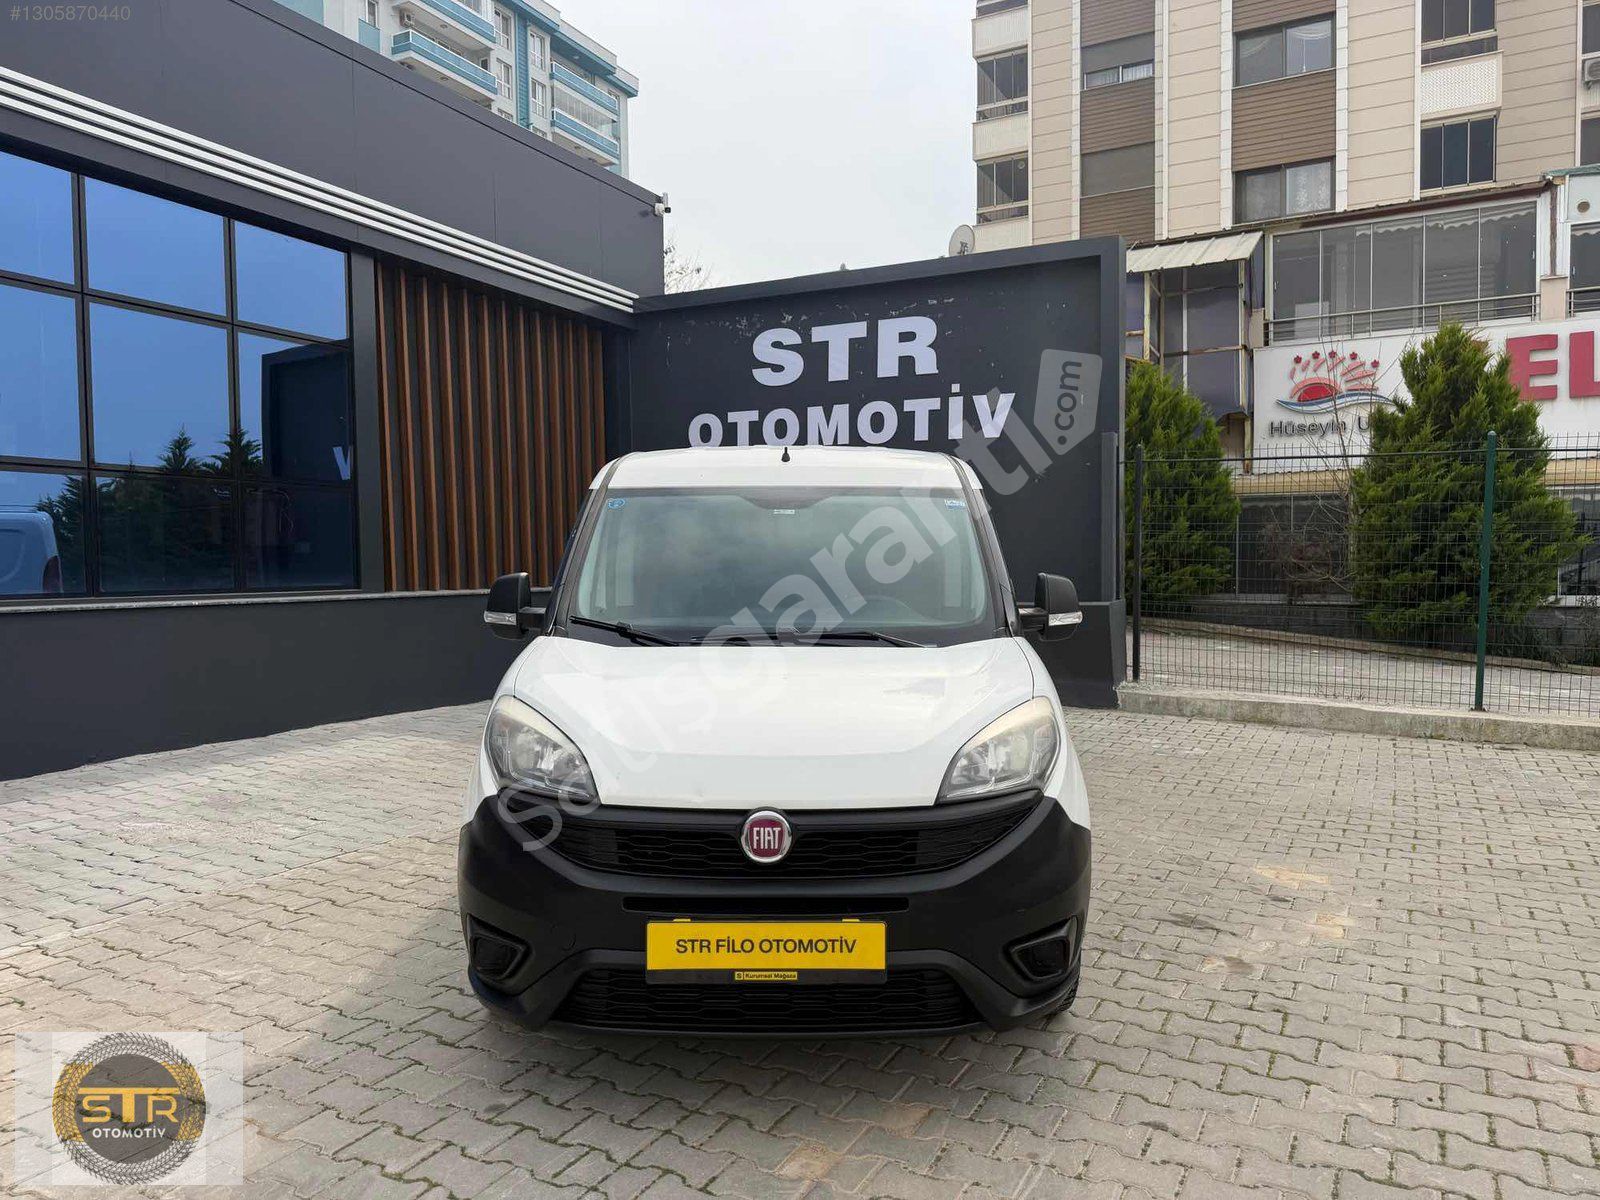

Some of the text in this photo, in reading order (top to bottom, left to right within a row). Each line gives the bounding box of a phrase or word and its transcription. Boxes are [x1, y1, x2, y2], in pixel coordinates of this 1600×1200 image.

[752, 316, 939, 387] STR
[688, 383, 1016, 448] OTOMOTİV
[1269, 419, 1347, 437] Hüseyin
[753, 827, 781, 850] FIAT
[675, 936, 857, 954] STR FİLO OTOMOTİV
